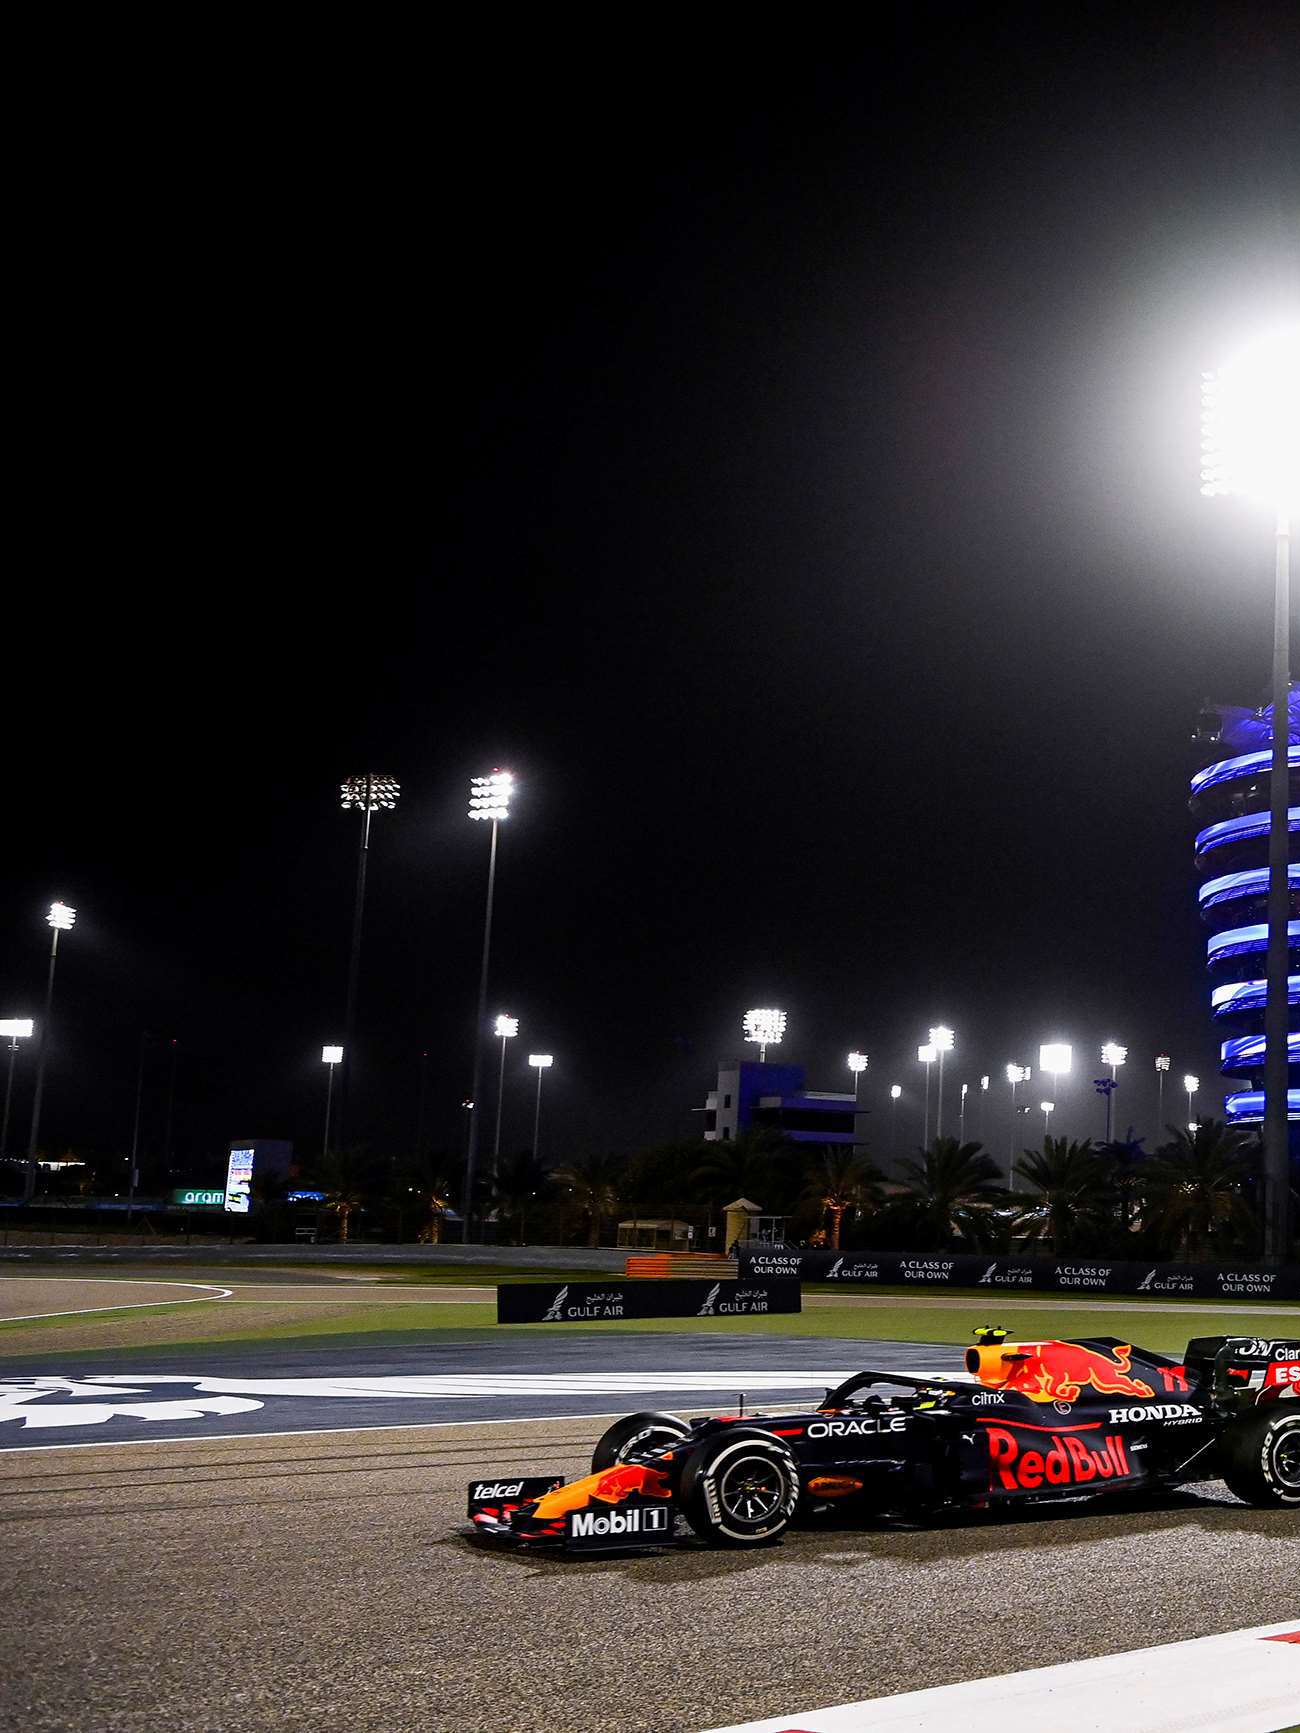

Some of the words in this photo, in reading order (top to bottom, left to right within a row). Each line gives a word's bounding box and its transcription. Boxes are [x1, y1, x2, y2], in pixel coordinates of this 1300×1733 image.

[758, 1257, 788, 1265] CLASS
[908, 1261, 939, 1269] CLASS
[941, 1262, 954, 1270] OF
[754, 1266, 774, 1274] OUR
[775, 1266, 797, 1274] OWN
[1064, 1267, 1096, 1276] CLASS
[1098, 1268, 1112, 1276] OF
[1060, 1277, 1081, 1285] OUR
[1082, 1277, 1106, 1286] OWN
[1217, 1273, 1224, 1281] A
[1227, 1273, 1260, 1282] CLASS
[1262, 1274, 1277, 1282] OF
[1179, 1282, 1194, 1290] AIR
[1222, 1283, 1244, 1292] OUR
[1246, 1284, 1271, 1292] OWN
[568, 1306, 600, 1317] GULF
[603, 1306, 624, 1315] AIR
[719, 1303, 748, 1312] GULF
[750, 1302, 768, 1311] AIR
[972, 1390, 1005, 1406] citrix
[1108, 1404, 1202, 1424] HONDA
[1163, 1417, 1203, 1427] HYBRID
[807, 1417, 907, 1438] ORACLE
[474, 1482, 524, 1499] telcel
[572, 1509, 640, 1537] Mobil
[650, 1510, 659, 1528] 1
